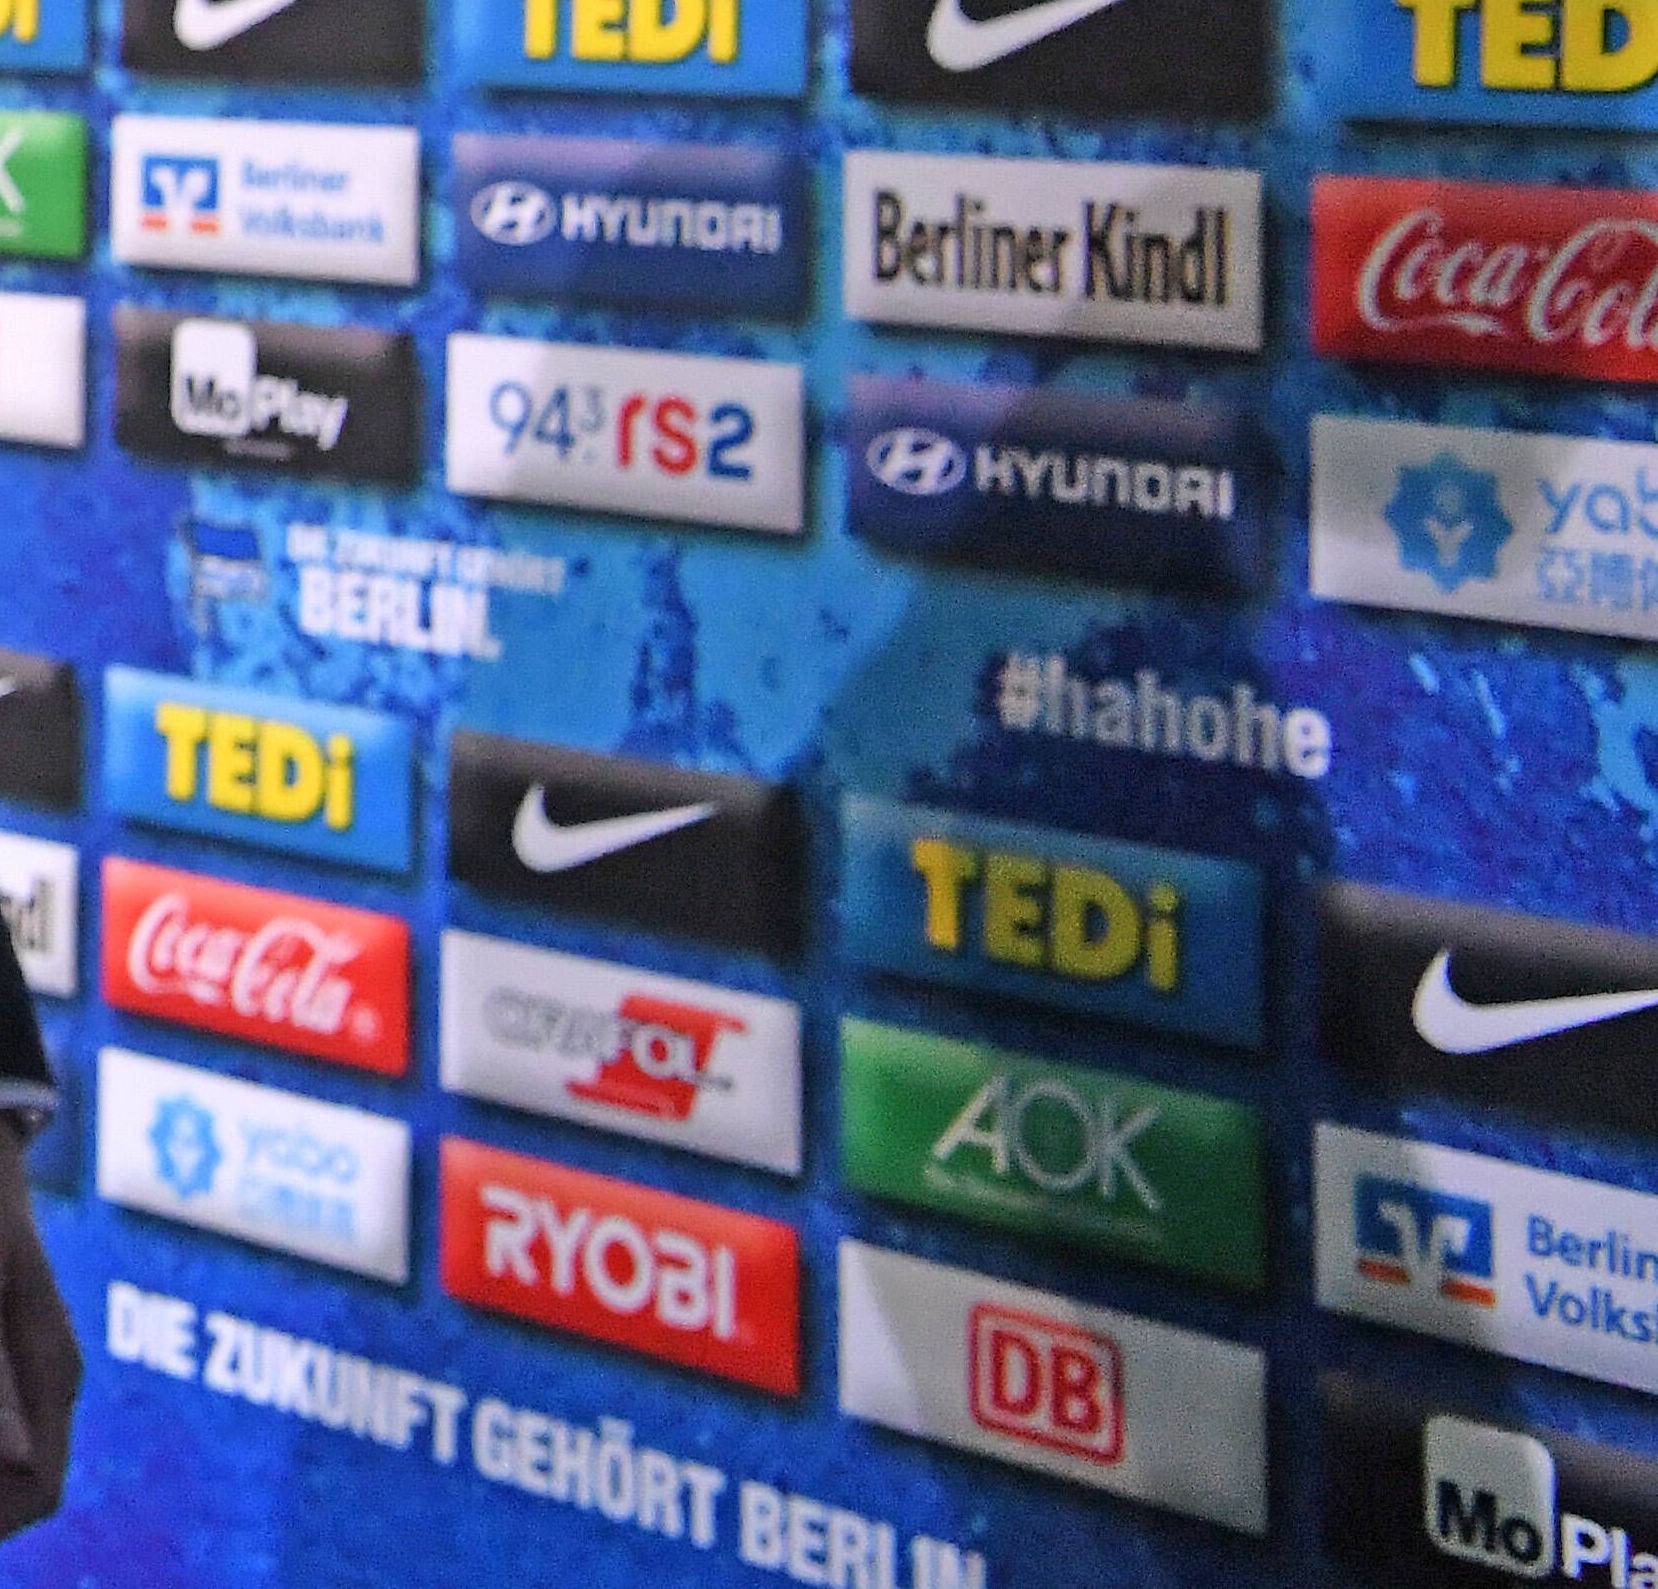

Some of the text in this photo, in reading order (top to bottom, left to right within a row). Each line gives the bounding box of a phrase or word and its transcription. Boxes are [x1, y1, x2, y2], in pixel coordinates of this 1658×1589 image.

[560, 193, 783, 255] HYUNDAI
[872, 188, 1231, 306] Berliner Kindl
[975, 443, 1236, 520] HYUNDAI
[155, 701, 355, 831] TEDi
[995, 651, 1332, 780] #hahohe
[912, 837, 1182, 994] TEDi
[932, 1066, 1162, 1212] AOK
[479, 1183, 739, 1342] RYOBI
[1524, 1271, 1658, 1344] Volks
[105, 1279, 198, 1382] DIE
[202, 1310, 468, 1466] ZUKUNFT
[470, 1394, 728, 1550] GEHÖRT
[987, 1328, 1106, 1437] DB
